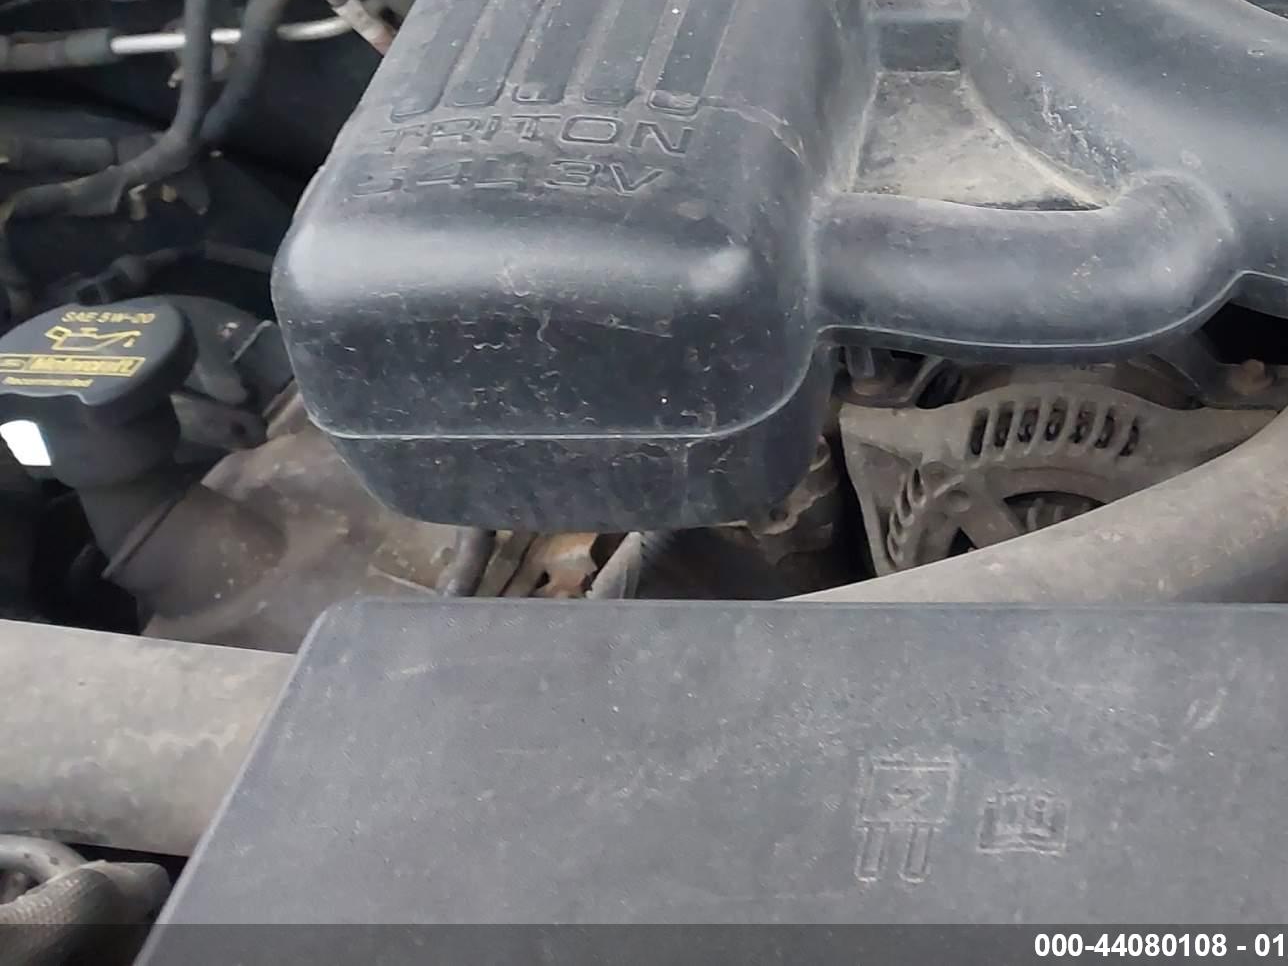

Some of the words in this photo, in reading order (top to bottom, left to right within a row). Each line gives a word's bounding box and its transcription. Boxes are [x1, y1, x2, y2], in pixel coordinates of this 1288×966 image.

[381, 113, 694, 158] TRITON
[545, 159, 665, 197] 3V
[61, 311, 98, 323] SAE
[98, 312, 156, 324] 5W-20
